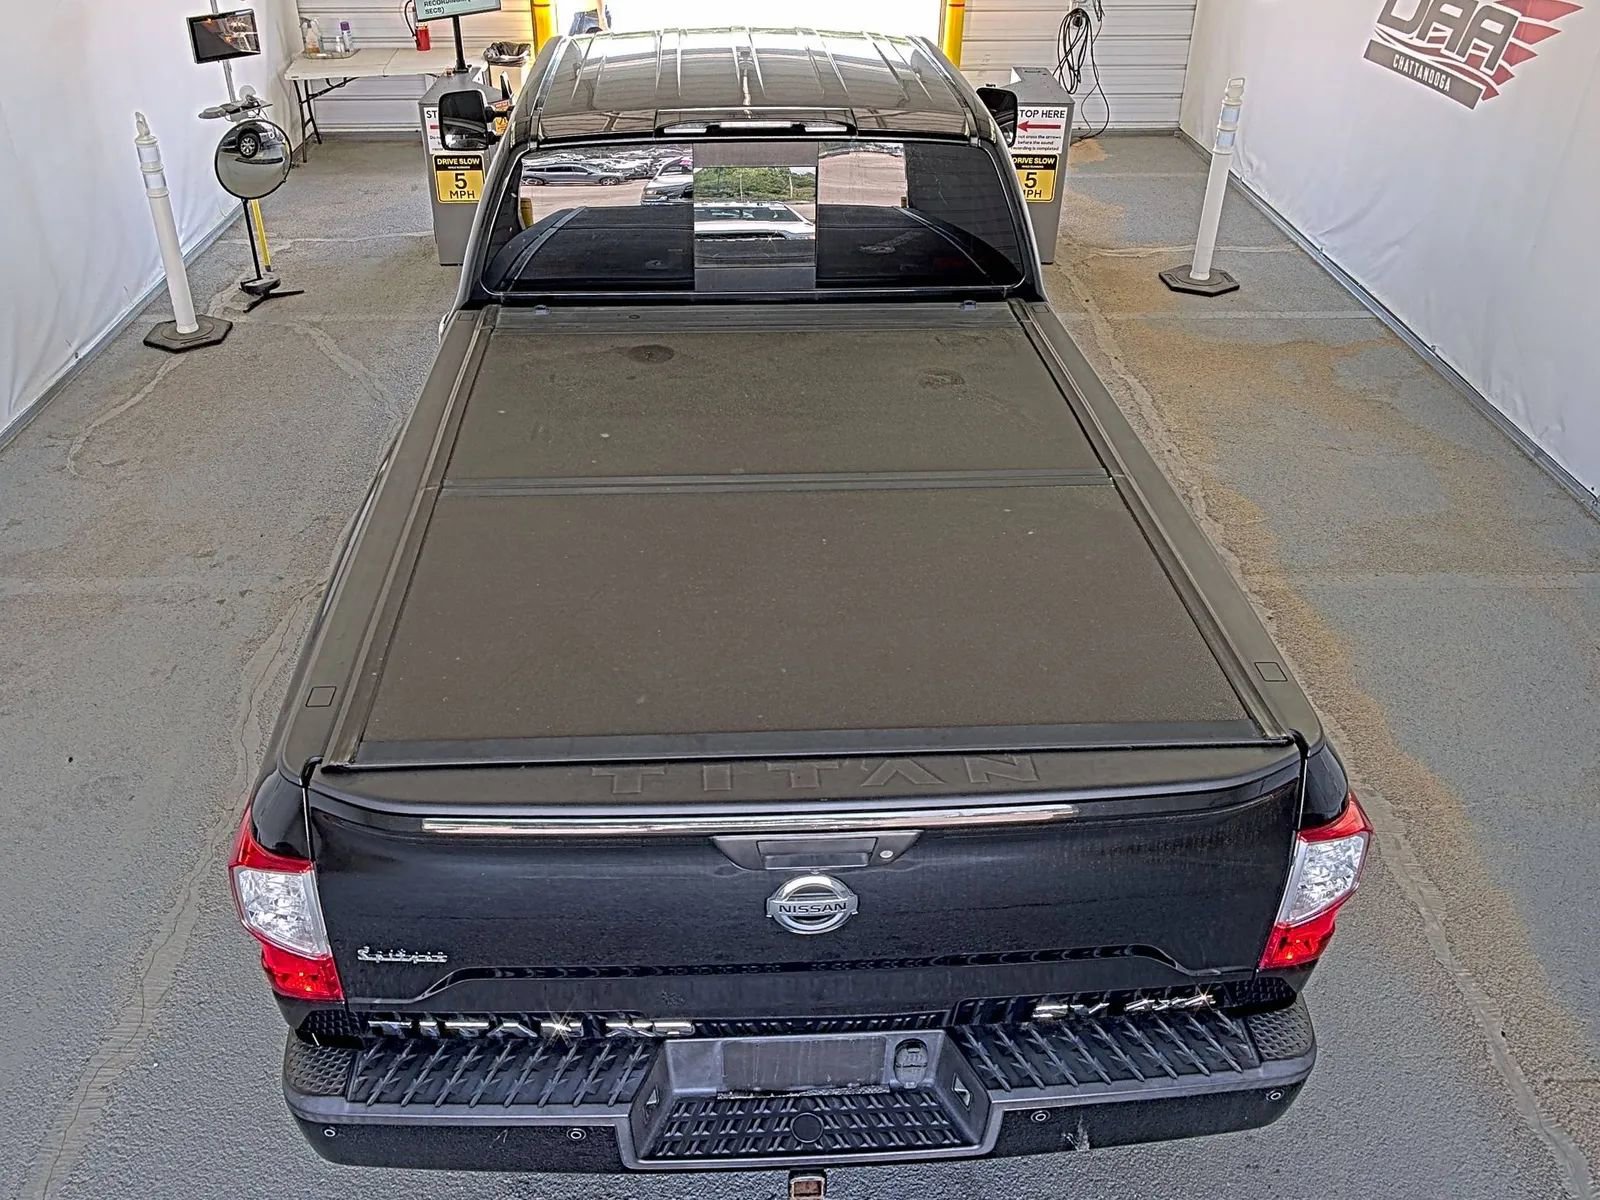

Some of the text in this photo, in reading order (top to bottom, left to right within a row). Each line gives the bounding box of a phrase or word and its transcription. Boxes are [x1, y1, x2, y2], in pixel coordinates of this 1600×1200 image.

[1392, 54, 1451, 92] CHATTANOOGA
[426, 110, 437, 119] ST
[1019, 109, 1065, 119] TOP HERE
[1034, 157, 1055, 165] SLOW
[454, 172, 467, 190] 5
[1024, 172, 1037, 188] 5
[449, 190, 475, 199] MPH
[591, 754, 1040, 795] TITAN
[779, 903, 846, 913] NISSAN
